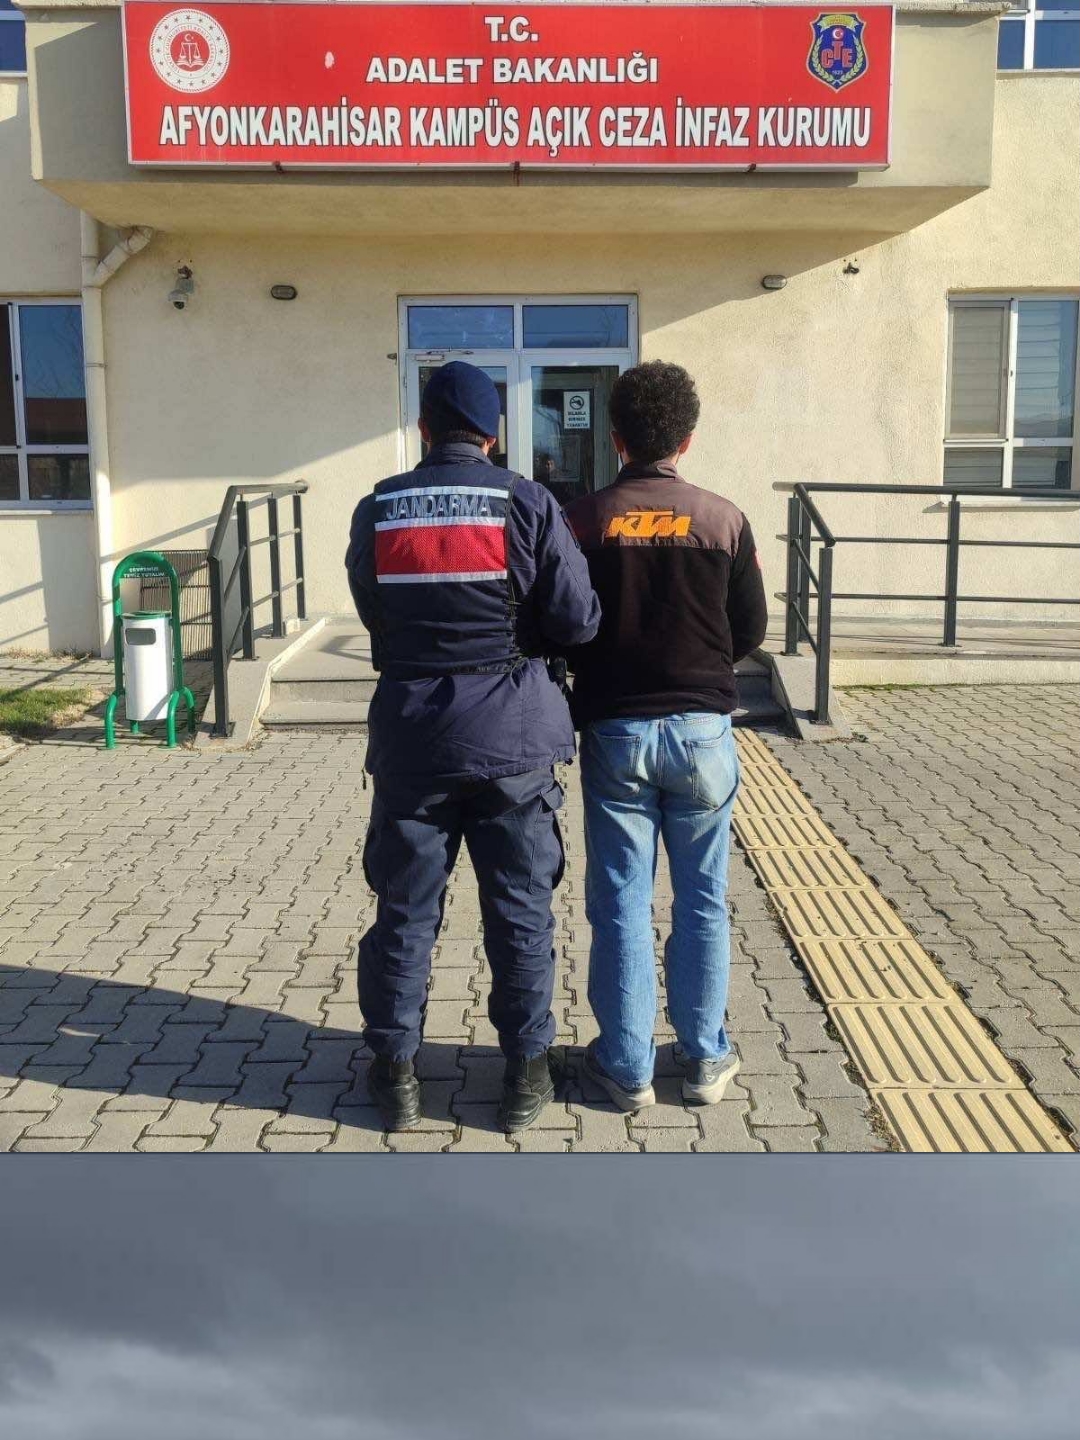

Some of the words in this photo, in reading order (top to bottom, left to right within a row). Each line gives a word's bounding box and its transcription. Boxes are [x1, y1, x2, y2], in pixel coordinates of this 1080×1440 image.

[484, 15, 540, 42] T.C.
[366, 56, 484, 83] ADALET
[492, 51, 658, 84] BAKANLIĞI
[159, 96, 401, 147] AFYONKARAHİSAR
[409, 98, 520, 147] KAMPÜS
[526, 106, 591, 157] AÇIK
[599, 106, 668, 148] CEZA
[675, 97, 750, 148] İNFAZ
[757, 106, 872, 148] KURUMU
[386, 494, 492, 520] JANDARMA
[606, 511, 691, 538] KTM
